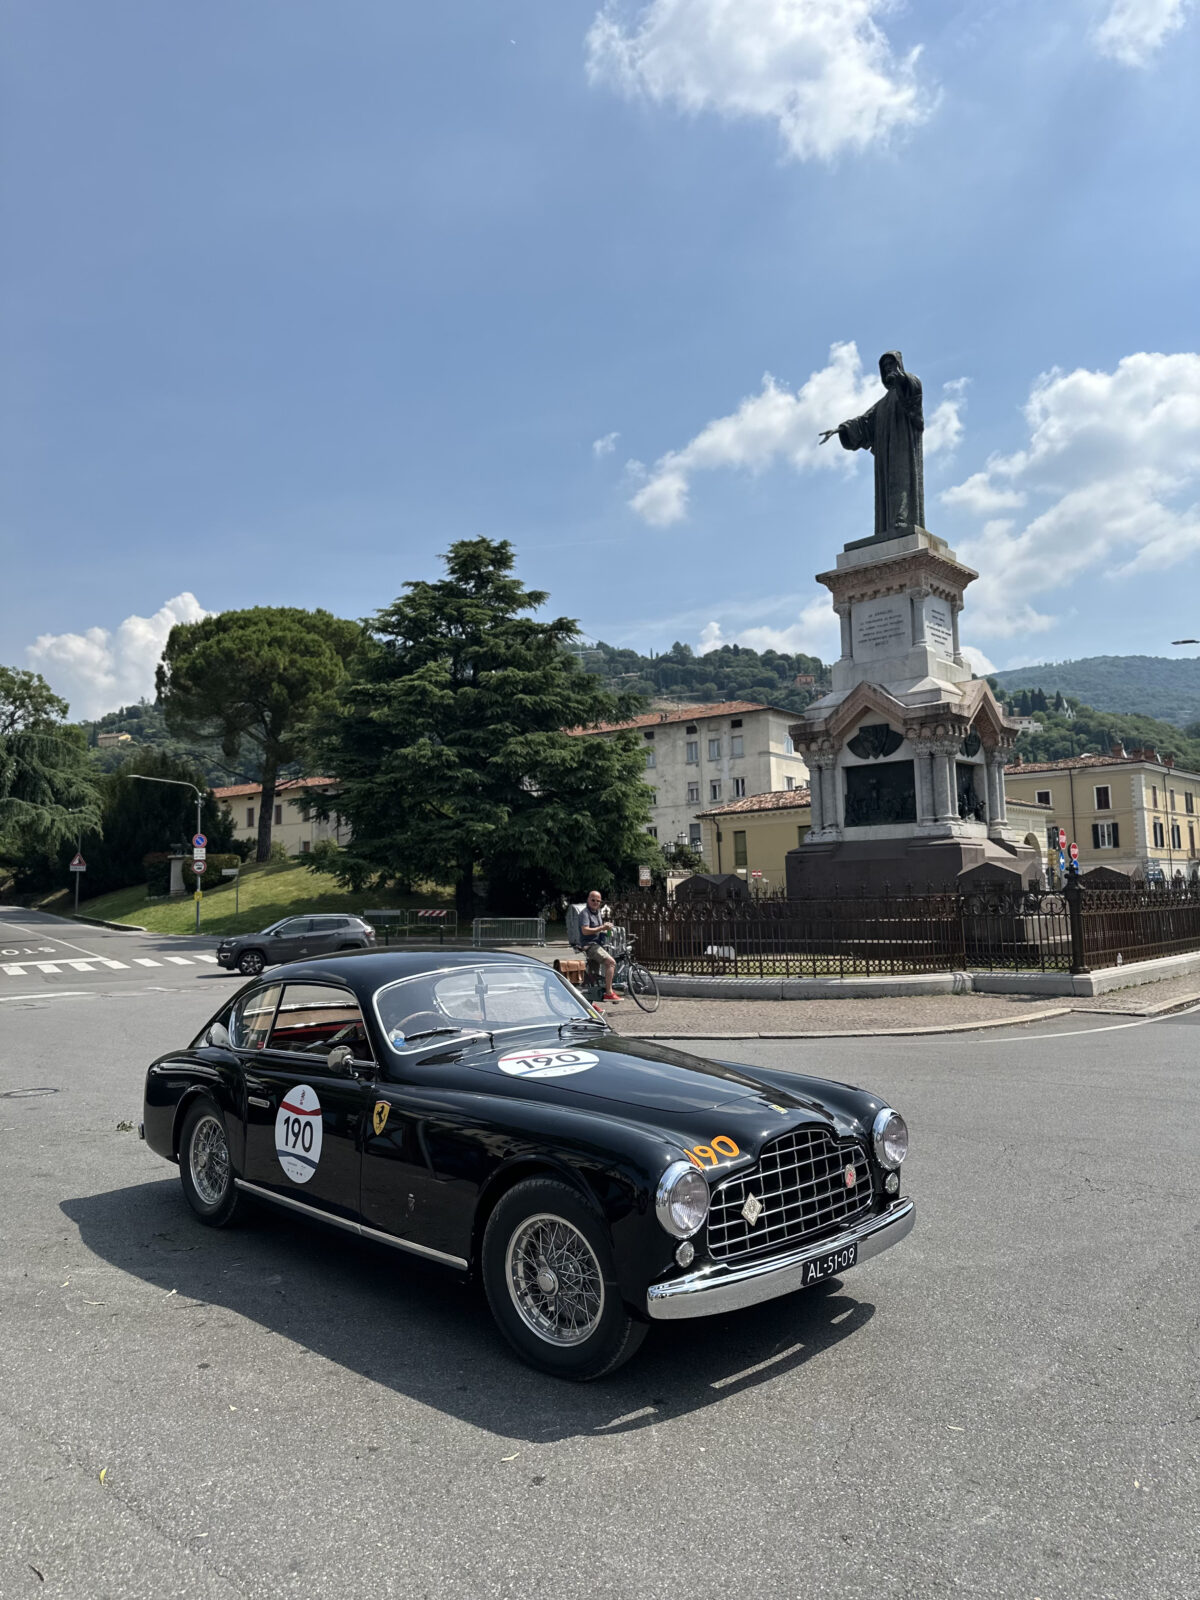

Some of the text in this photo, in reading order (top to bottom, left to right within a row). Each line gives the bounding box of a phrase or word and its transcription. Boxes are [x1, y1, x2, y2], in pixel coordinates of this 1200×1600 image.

[0, 946, 57, 956] STO
[516, 1054, 581, 1069] 190
[283, 1115, 314, 1153] 190
[683, 1135, 740, 1170] 190
[807, 1247, 855, 1283] AL-51-09
